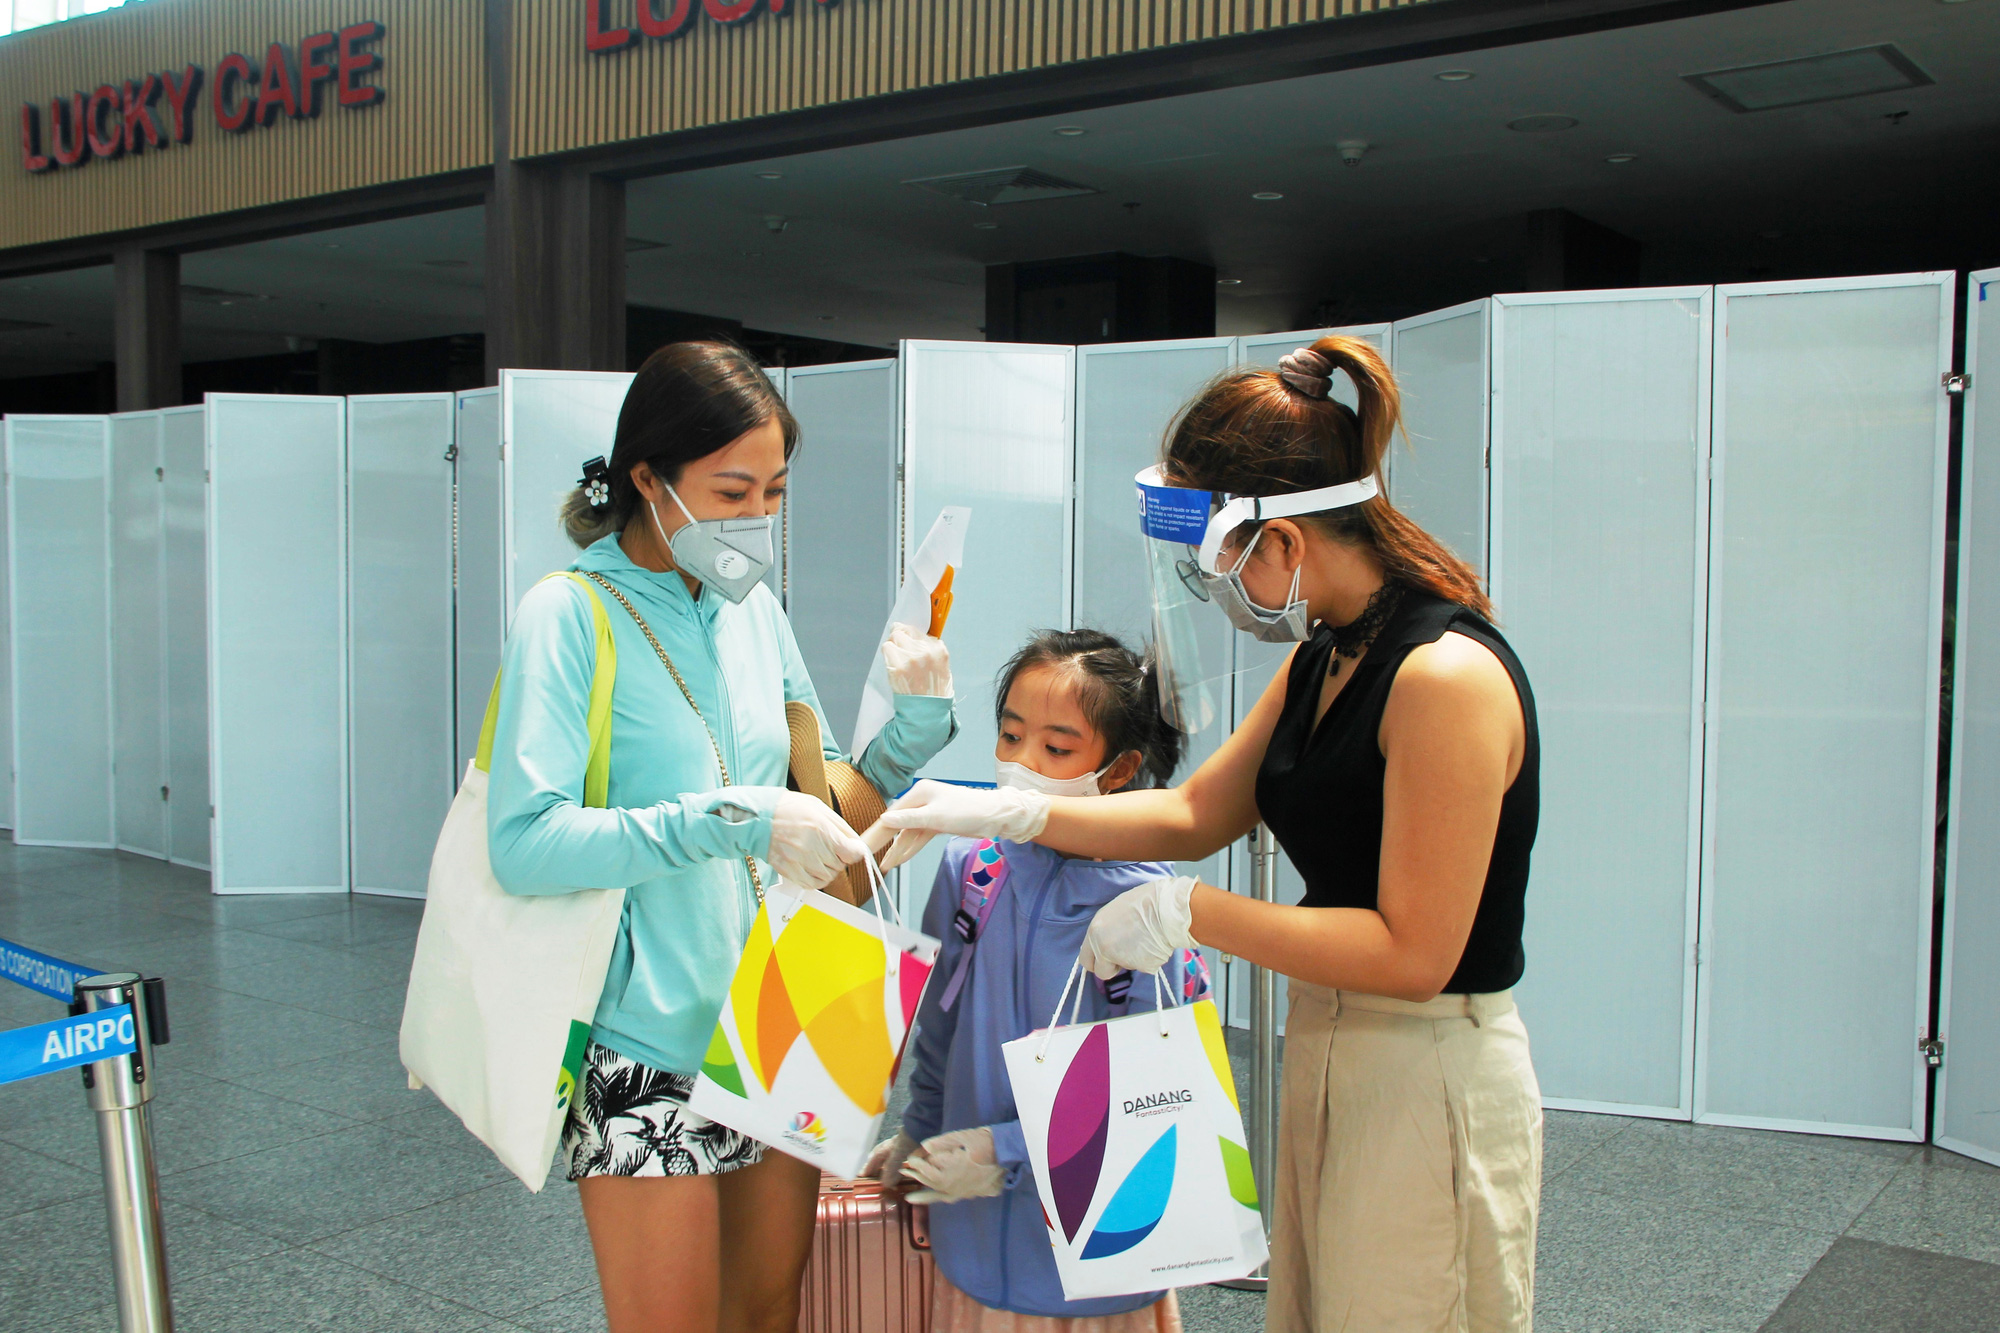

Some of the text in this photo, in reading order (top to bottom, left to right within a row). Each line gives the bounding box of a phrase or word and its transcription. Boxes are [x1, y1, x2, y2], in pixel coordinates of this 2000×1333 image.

[23, 20, 384, 172] LUCKY CAFE
[7, 949, 74, 996] CORPORATION
[42, 1013, 135, 1064] AIRPO
[1123, 1089, 1193, 1114] DANANG
